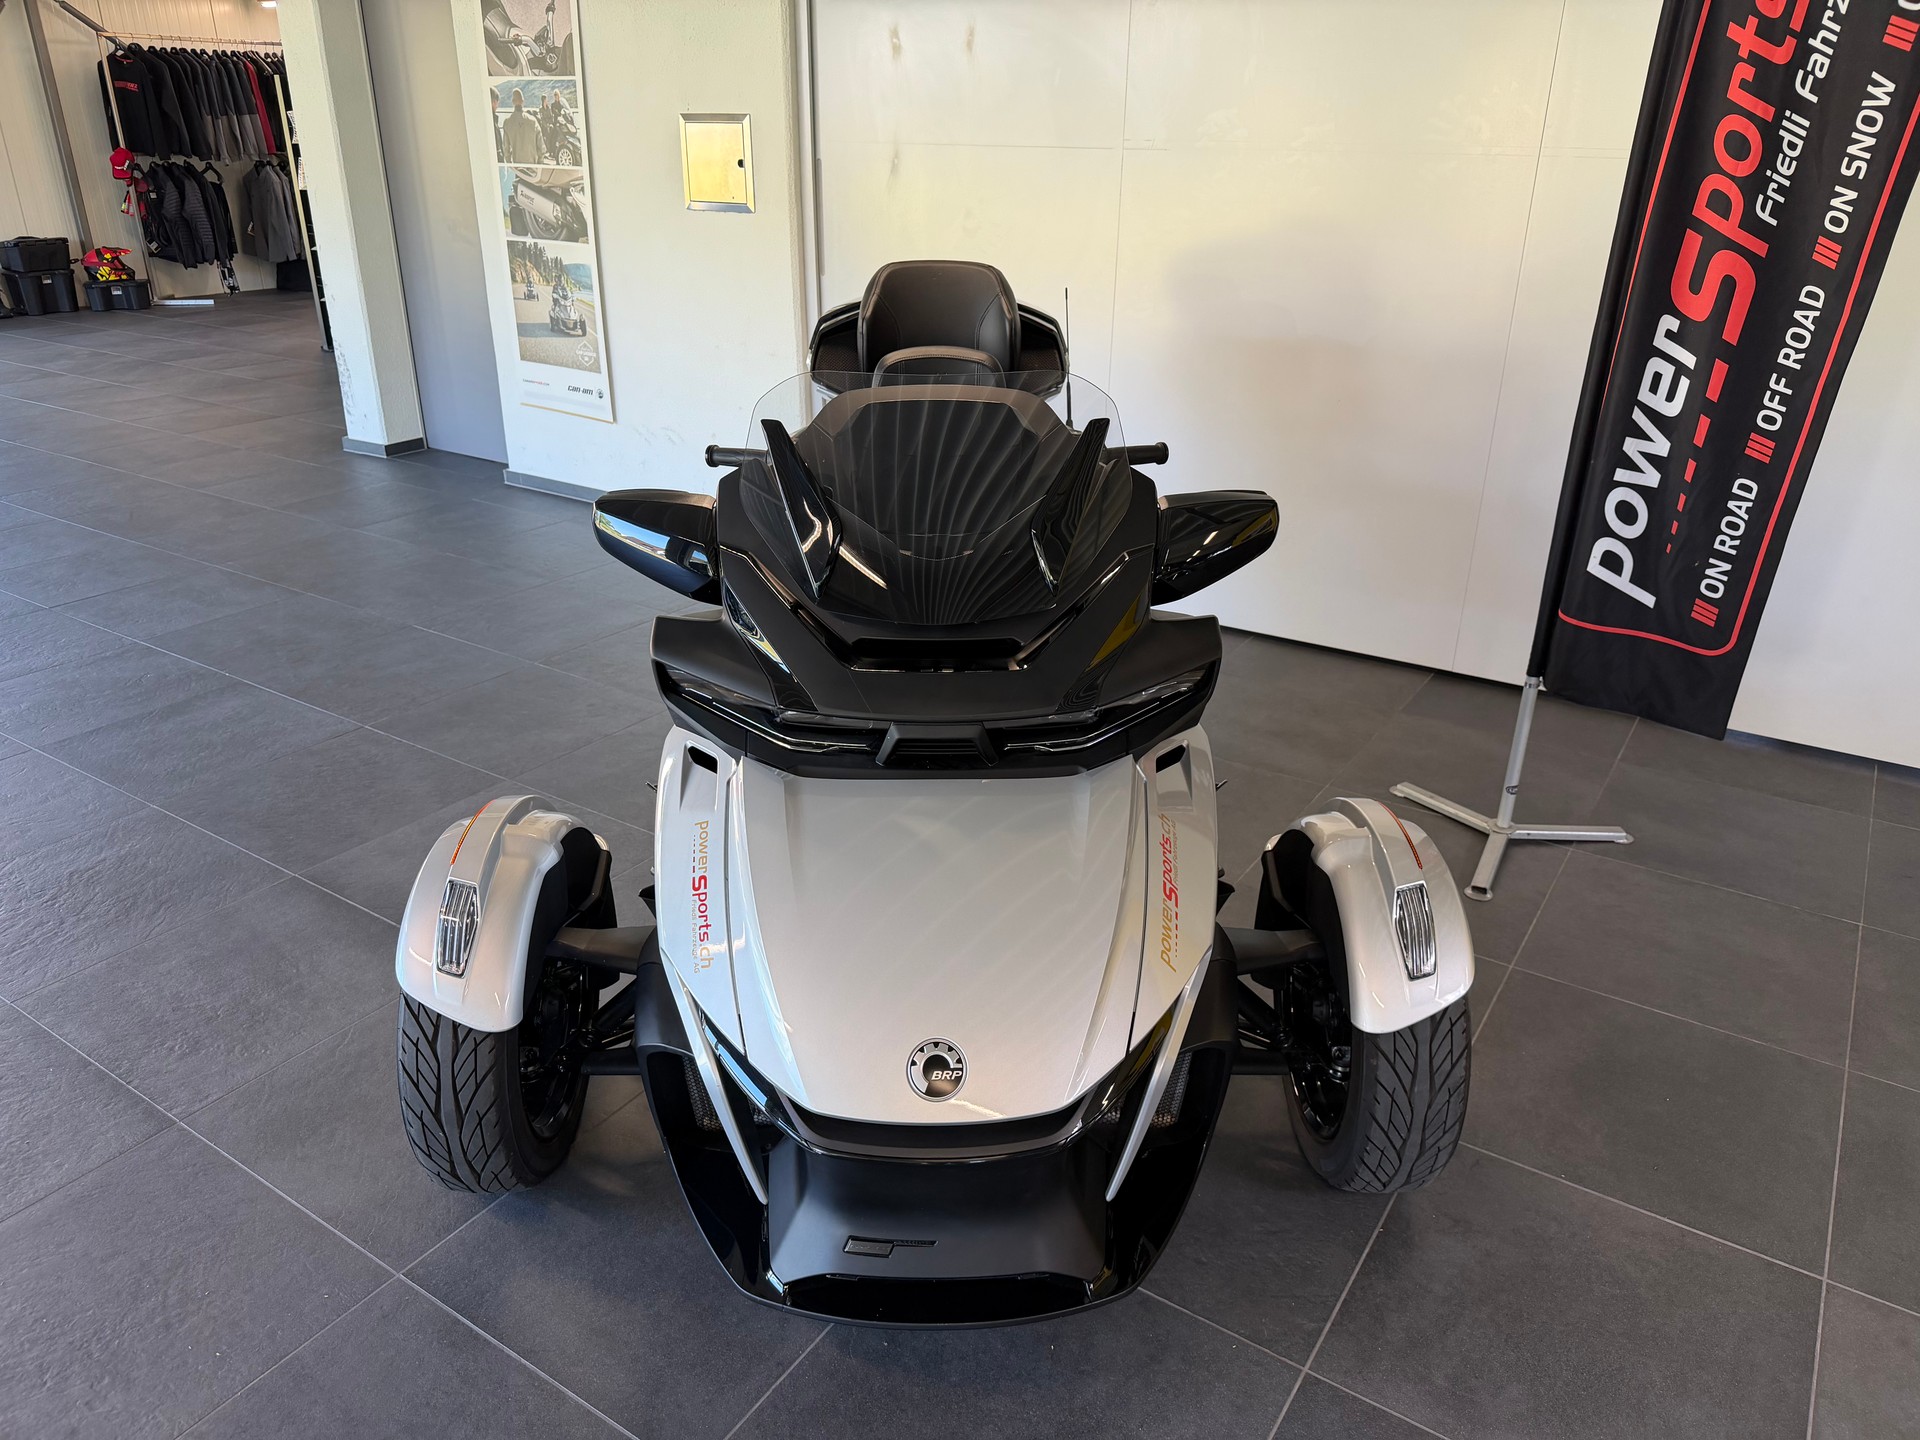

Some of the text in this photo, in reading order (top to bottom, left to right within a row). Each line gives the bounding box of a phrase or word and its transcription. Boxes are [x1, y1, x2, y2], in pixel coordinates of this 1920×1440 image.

[1755, 109, 1811, 227] Friedli
[1699, 71, 1897, 599] ON ROAD OFF ROAD ON SNOW
[931, 1070, 963, 1081] BRP
